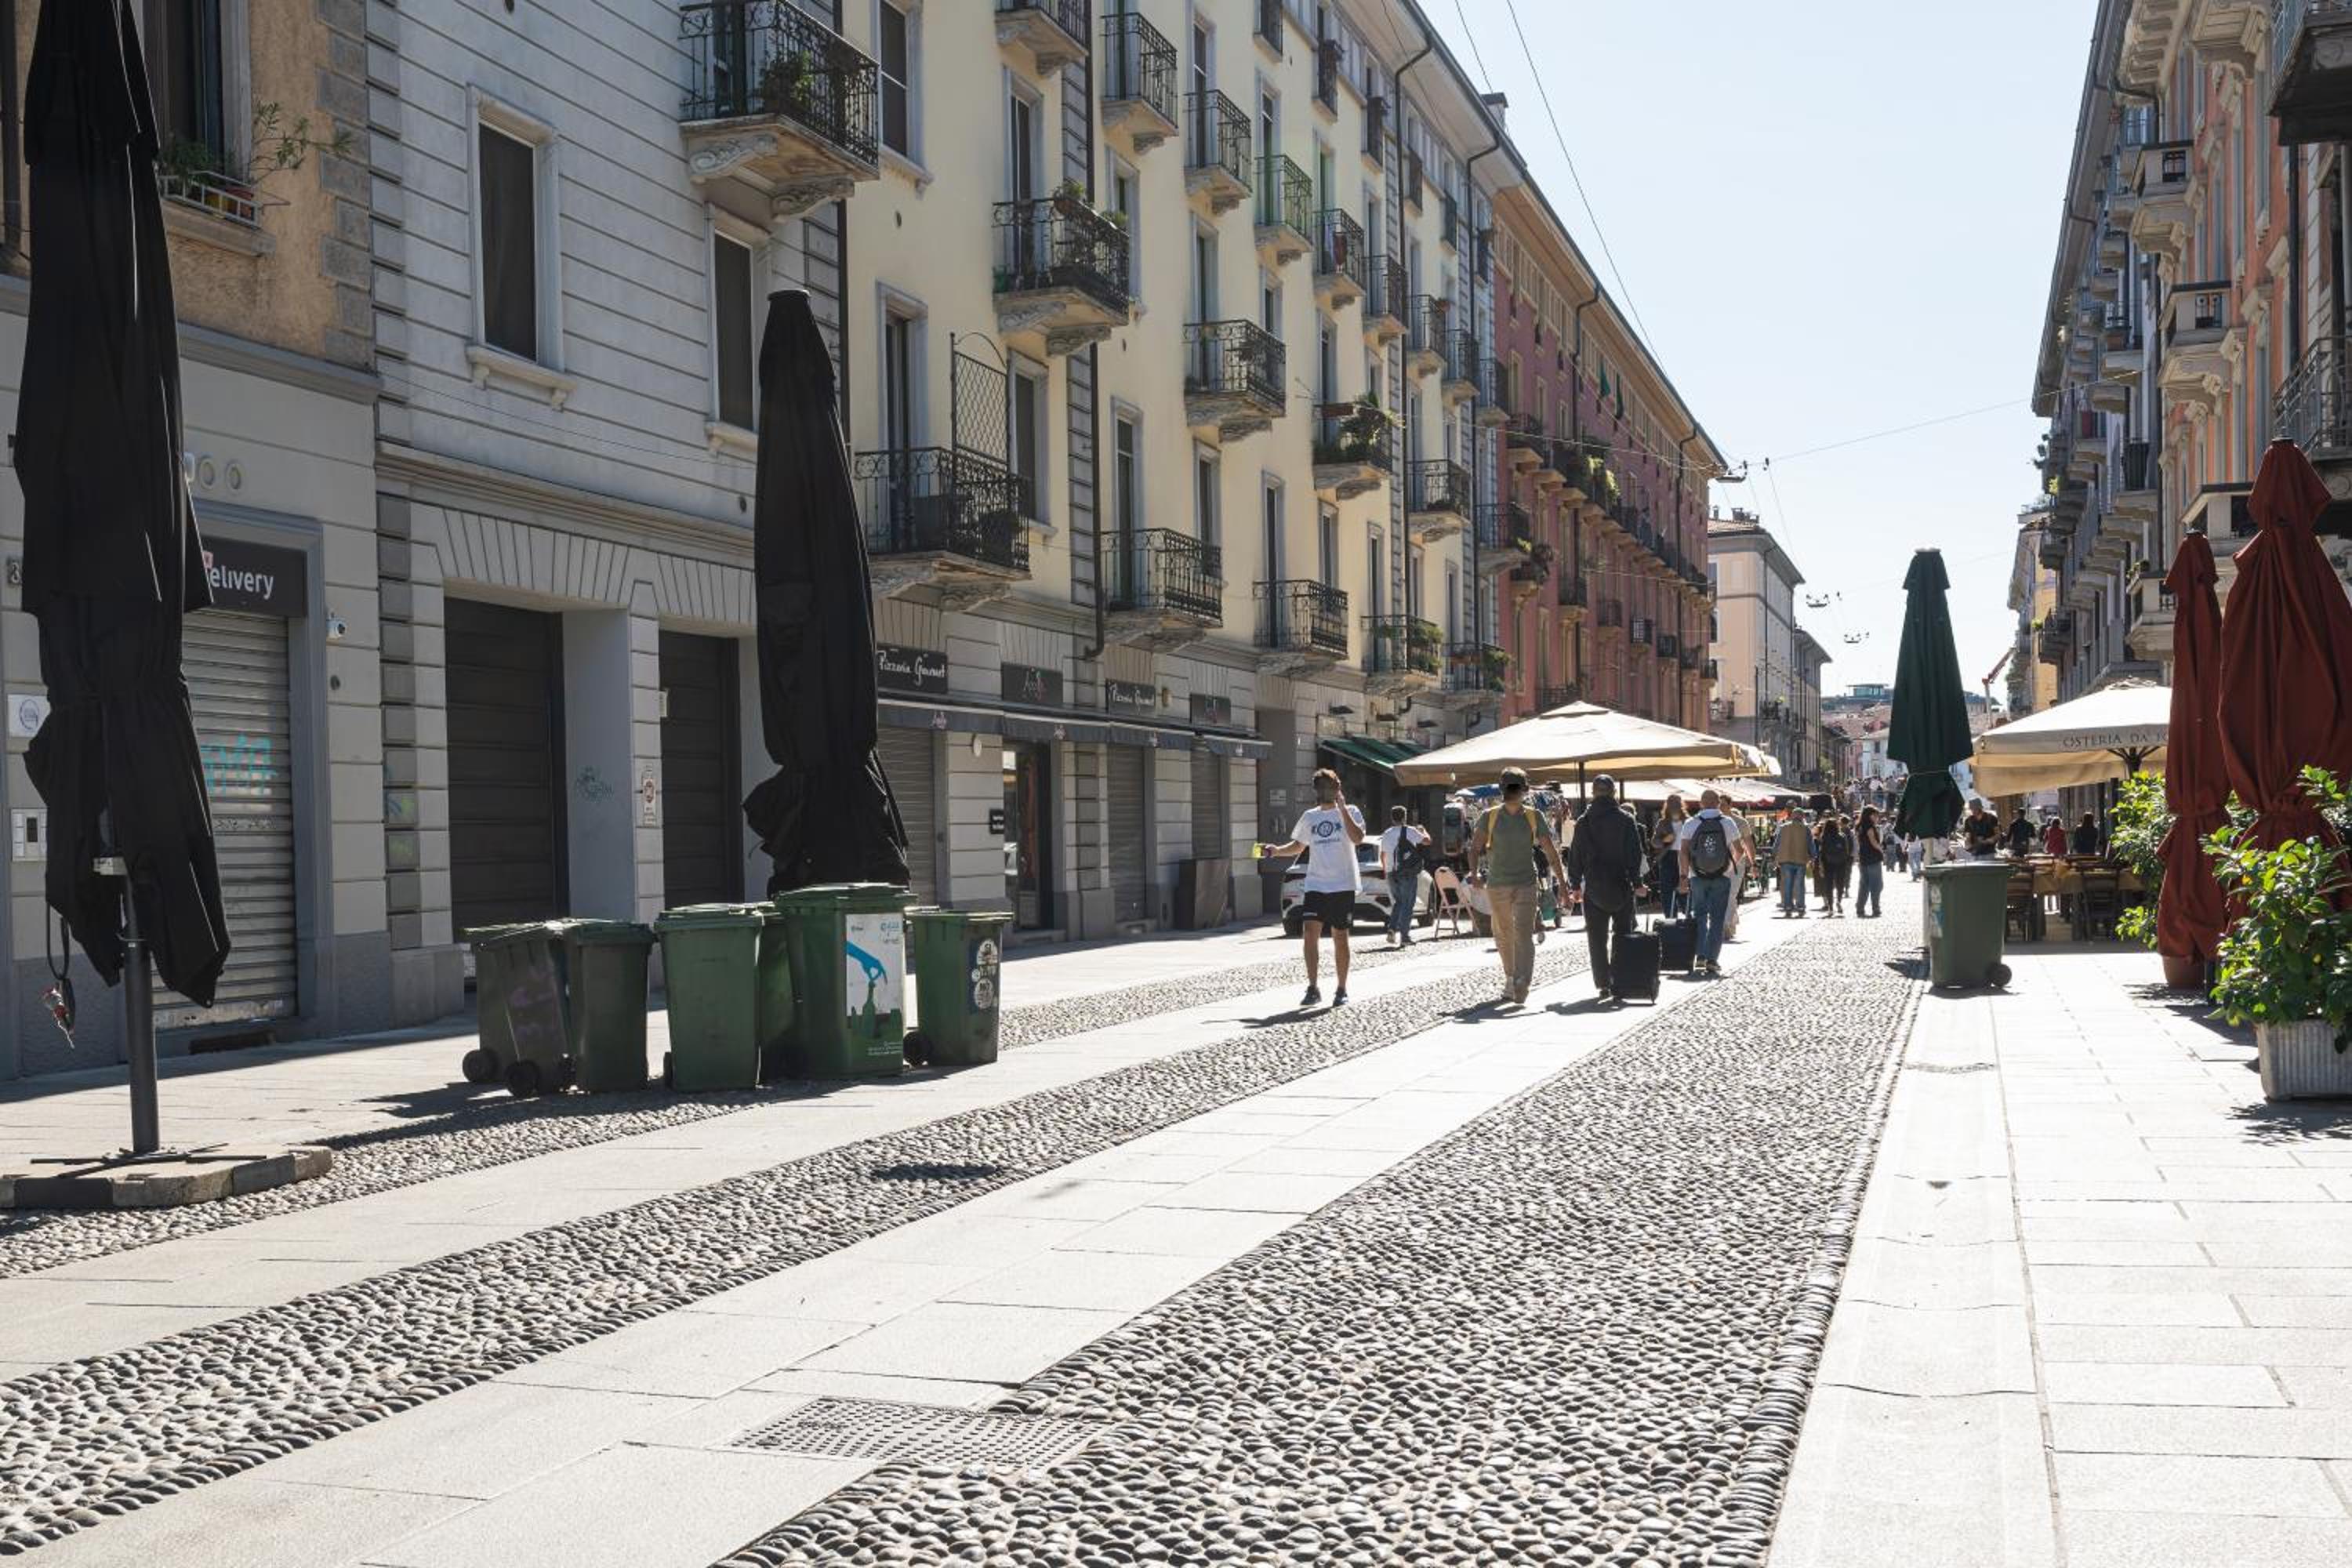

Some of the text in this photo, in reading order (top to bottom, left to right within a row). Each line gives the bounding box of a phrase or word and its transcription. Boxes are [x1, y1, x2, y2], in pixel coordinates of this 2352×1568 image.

[209, 564, 274, 600] elivery
[2063, 731, 2122, 747] OSTERIA
[2129, 732, 2149, 744] DA
